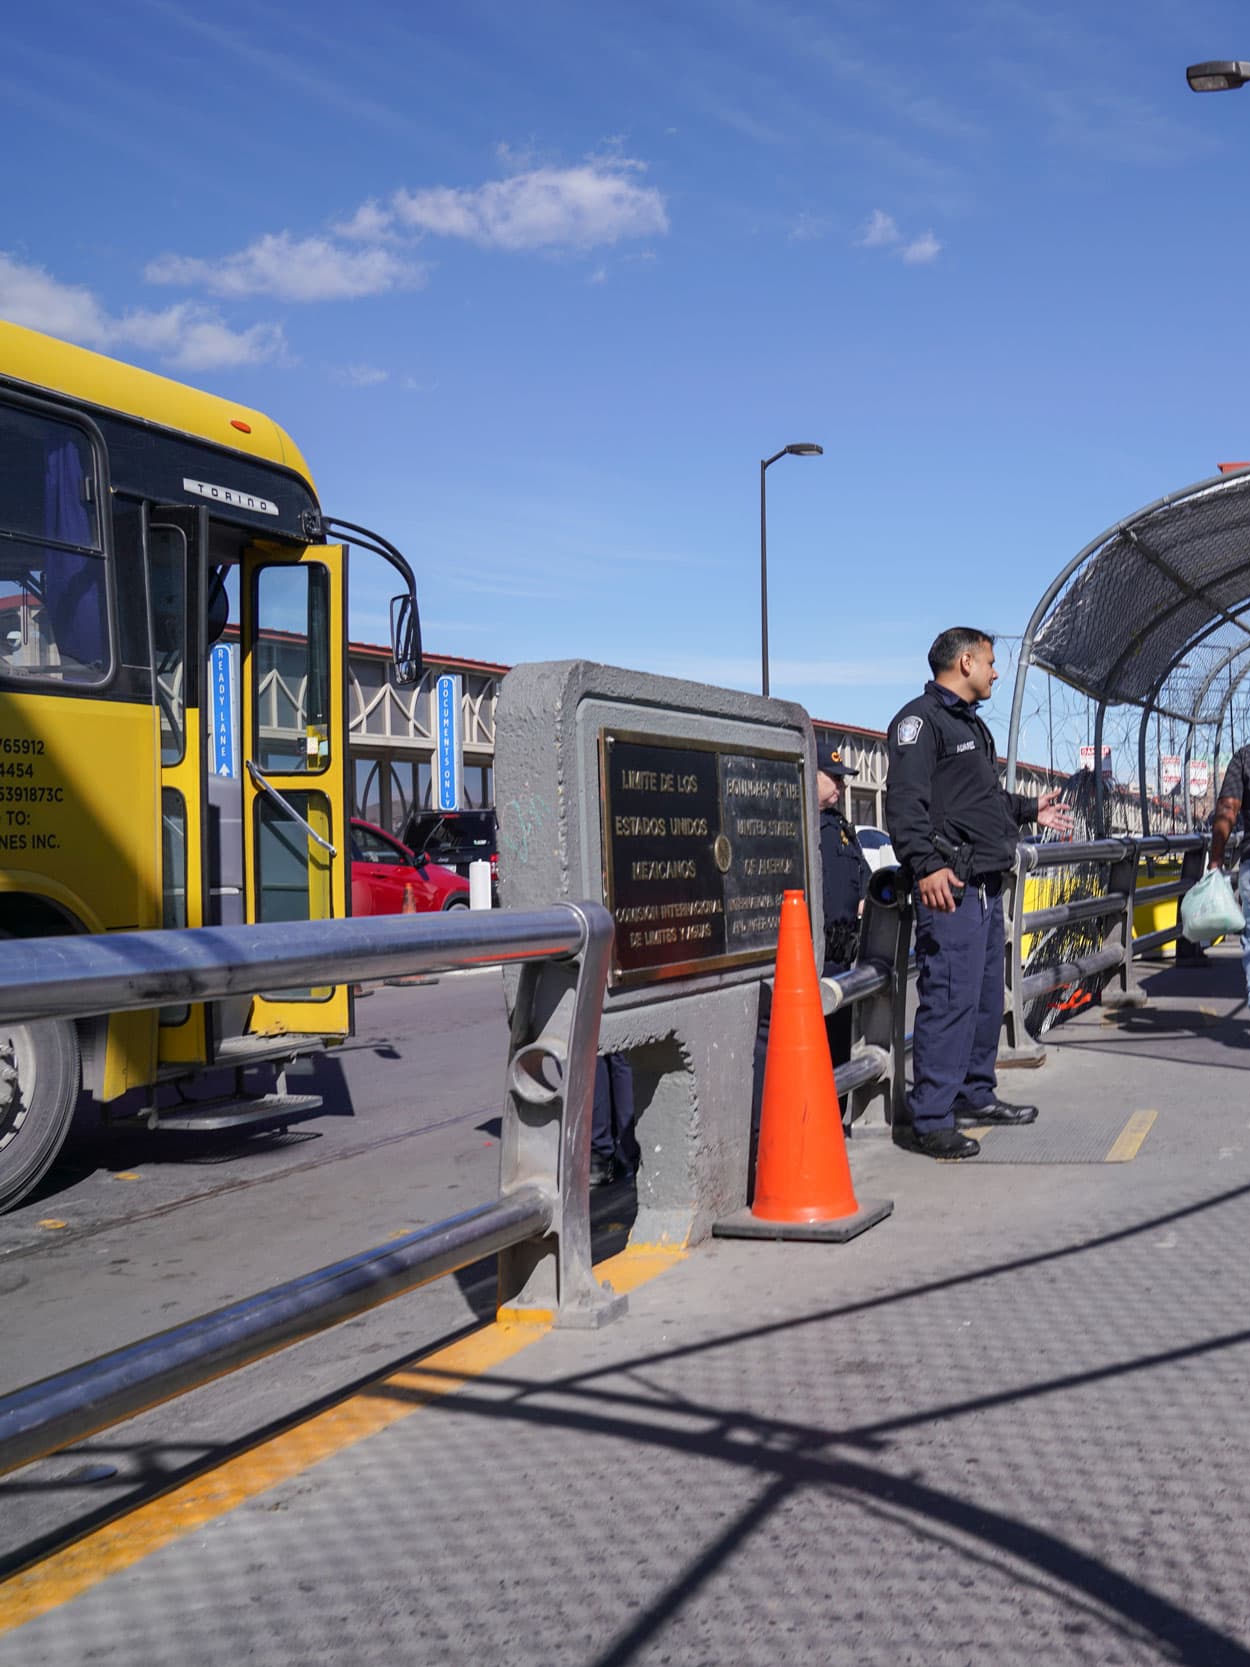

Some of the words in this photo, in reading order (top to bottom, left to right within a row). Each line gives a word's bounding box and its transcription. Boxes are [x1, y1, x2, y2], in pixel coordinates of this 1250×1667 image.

[197, 483, 267, 511] TORINO
[217, 648, 226, 706] READY
[442, 679, 450, 767] DOCUMENTS
[0, 738, 45, 755] 65912
[443, 769, 452, 808] ONLY
[622, 769, 657, 791] LIMITE
[660, 772, 674, 792] DE
[677, 774, 698, 793] LOS
[6, 810, 31, 826] TO:
[615, 815, 666, 836] ESTADOS
[669, 816, 708, 837] UNIDOS
[31, 834, 60, 849] INC.
[632, 859, 697, 880] MEXICANOS
[629, 931, 642, 949] DE
[643, 926, 678, 946] LIMITES
